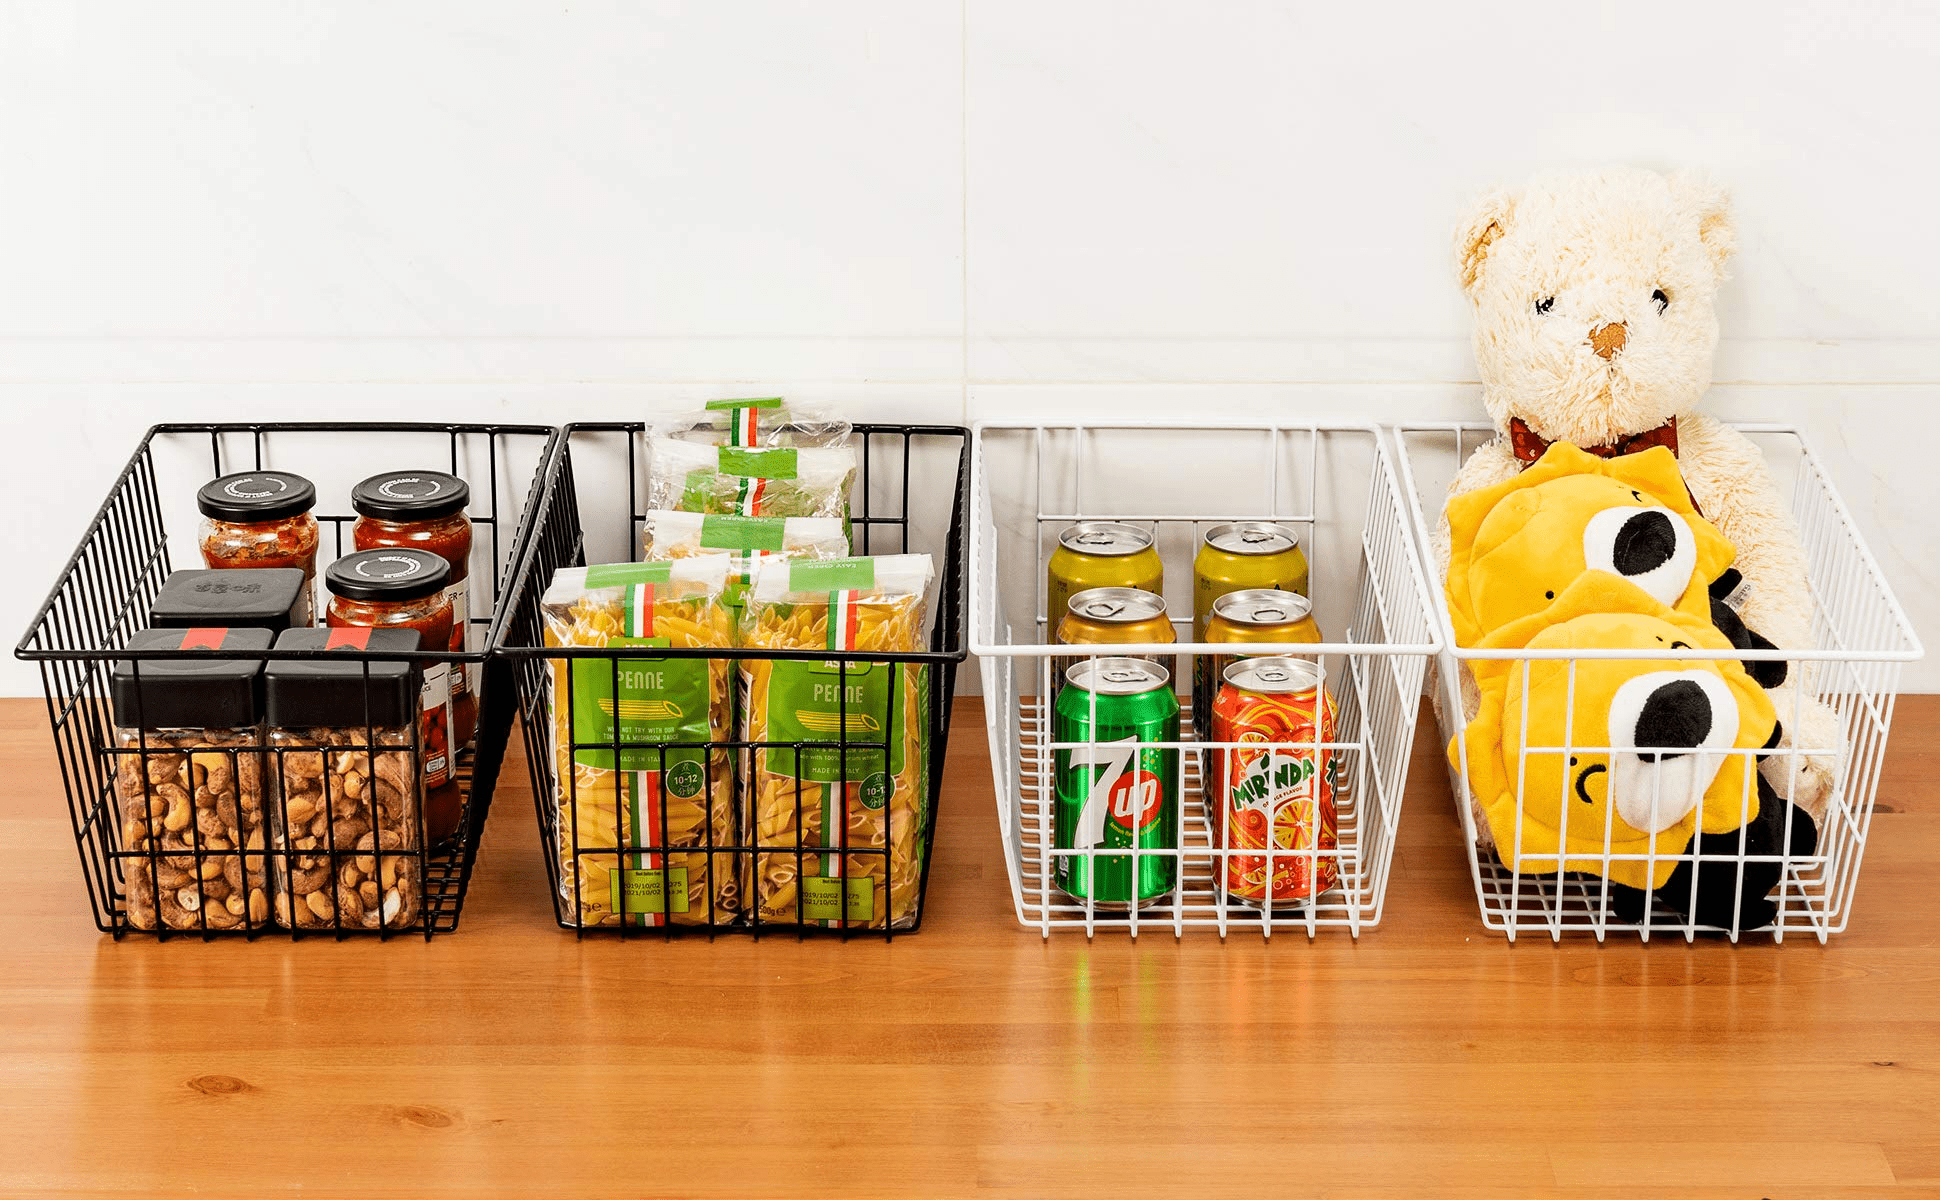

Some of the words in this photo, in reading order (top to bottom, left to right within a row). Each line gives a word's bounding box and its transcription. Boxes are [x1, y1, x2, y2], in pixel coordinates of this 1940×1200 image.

[616, 671, 665, 690] PENNE
[813, 683, 865, 704] PENNE
[647, 726, 663, 734] WITH
[673, 773, 698, 785] 10-12
[1232, 754, 1316, 810] MIRINDA
[866, 784, 886, 796] 10-1
[1069, 734, 1138, 850] 7
[1113, 778, 1158, 821] up
